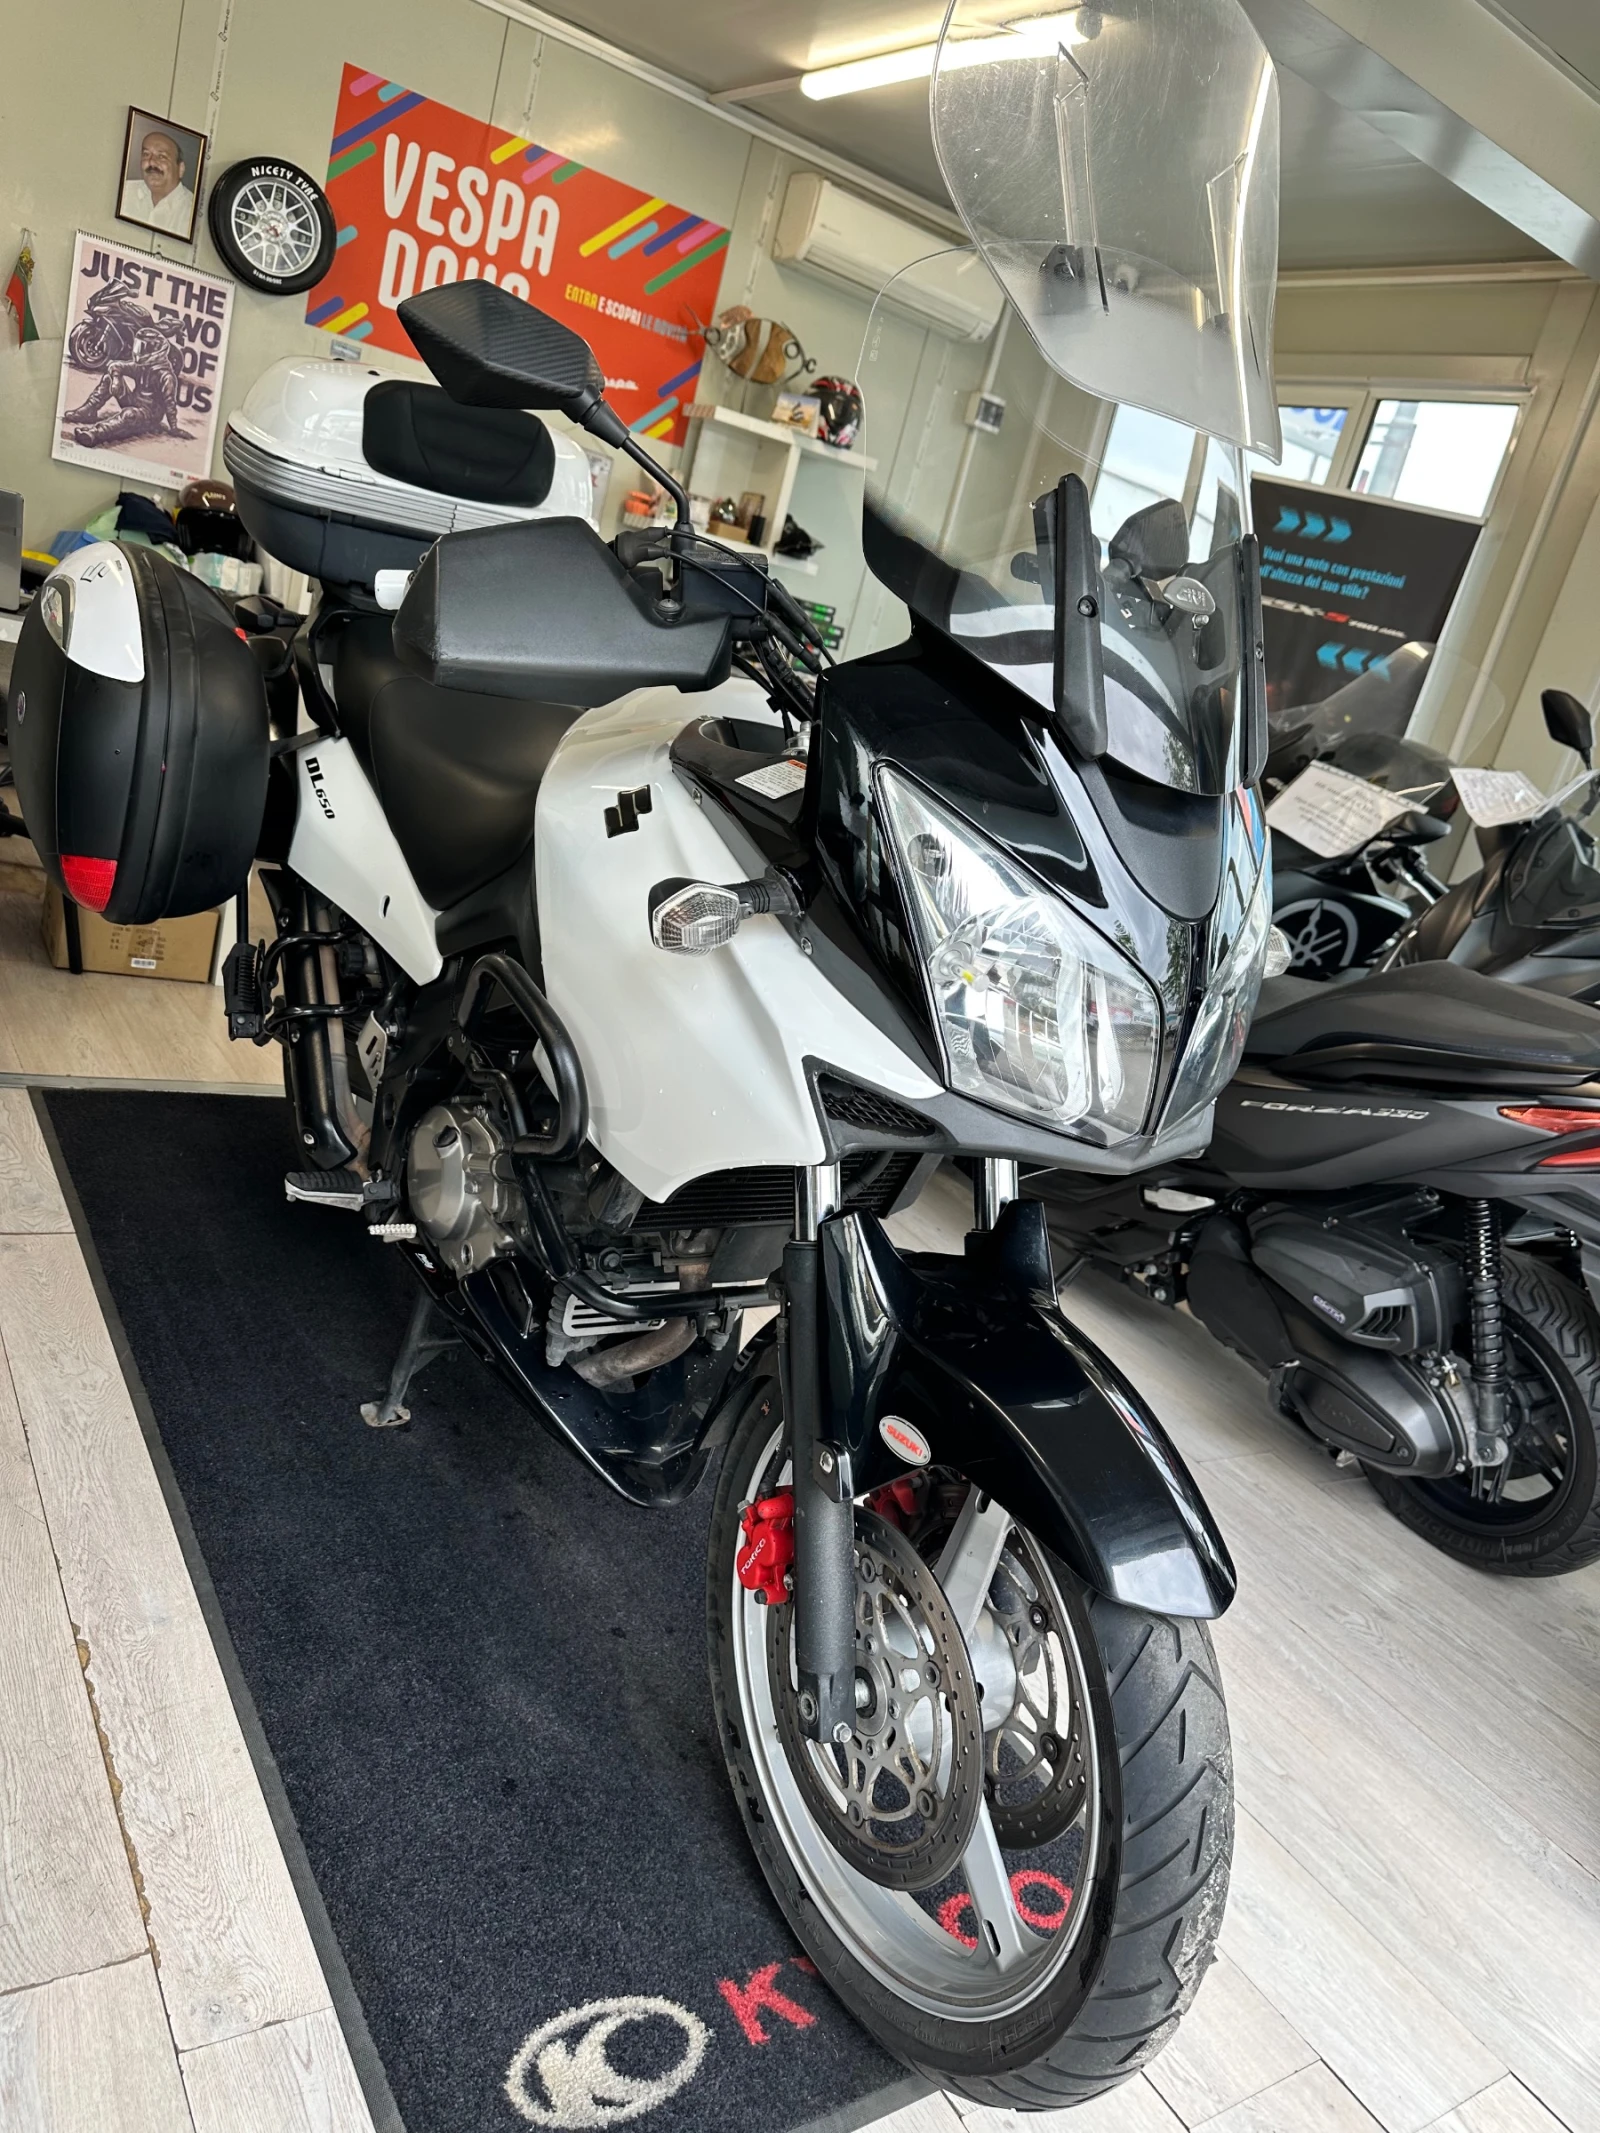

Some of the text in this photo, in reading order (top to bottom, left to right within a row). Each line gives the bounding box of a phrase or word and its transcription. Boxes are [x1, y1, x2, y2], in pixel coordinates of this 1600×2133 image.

[251, 165, 319, 201] NICETY TYRE
[383, 133, 560, 277] VESPA
[81, 250, 227, 319] JUST THE
[565, 283, 598, 310] ENTRA
[598, 296, 606, 313] E
[605, 299, 641, 327] SCOPRI
[182, 351, 219, 379] OF
[176, 382, 213, 414] US
[1263, 545, 1407, 590] Vuoi una moto con prestazioni
[1304, 573, 1321, 590] del
[1322, 579, 1339, 594] suo
[1340, 582, 1370, 601] stile?
[886, 1424, 923, 1457] SUZUKI
[741, 1538, 767, 1575] TOKICO
